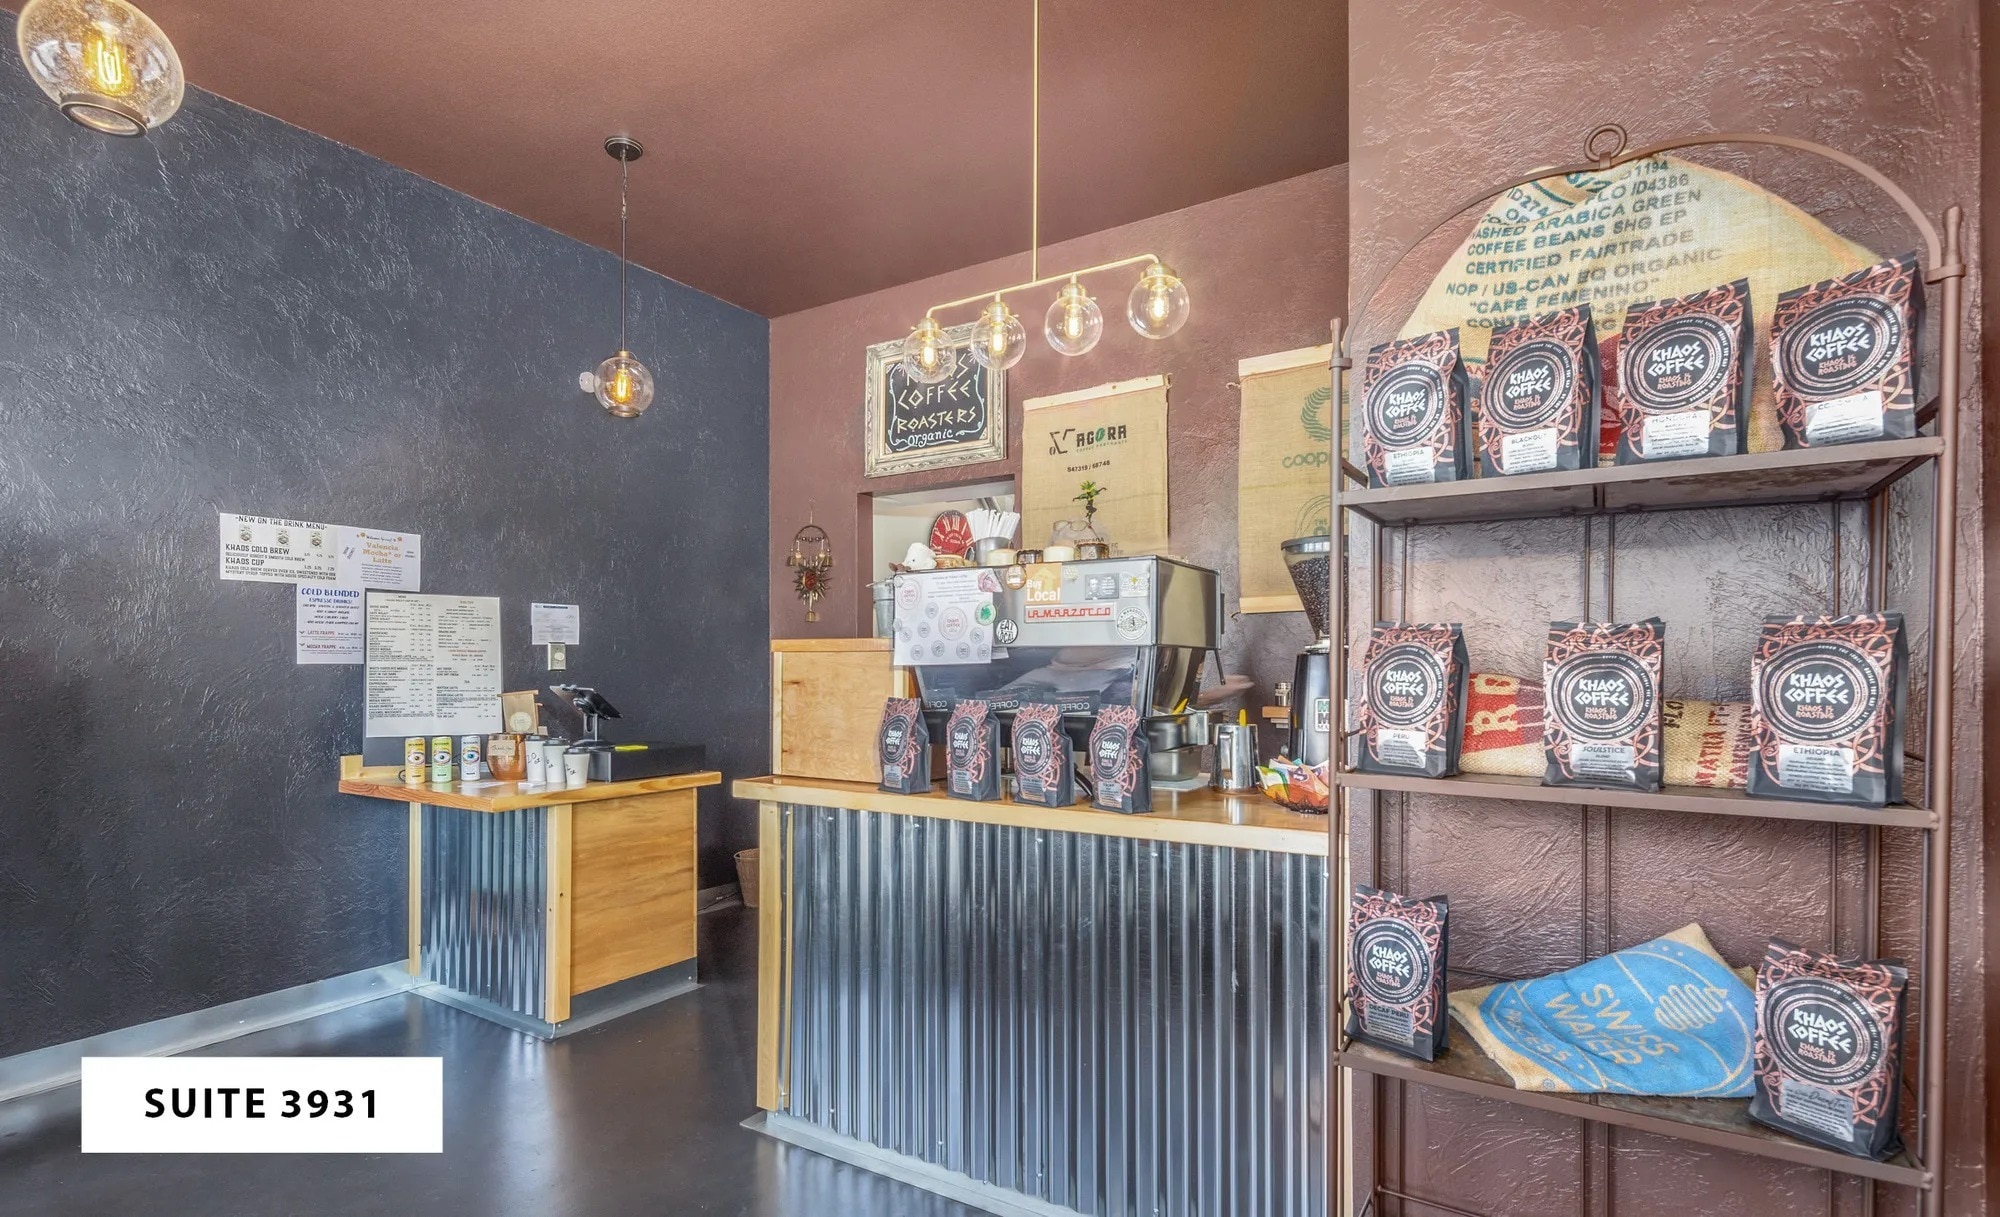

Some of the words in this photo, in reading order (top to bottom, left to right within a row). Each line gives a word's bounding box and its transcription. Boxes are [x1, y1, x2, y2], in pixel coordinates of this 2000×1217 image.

[1532, 203, 1626, 232] ARABICA
[1632, 189, 1701, 213] GREEN
[1467, 239, 1527, 257] COFFEE
[1534, 224, 1605, 249] BEANS
[1613, 217, 1652, 234] SHG
[1659, 210, 1688, 227] EP
[1465, 254, 1561, 275] CERTIFIED
[1569, 229, 1694, 262] FAIRTRADE
[1446, 282, 1478, 296] NOP
[1614, 248, 1722, 278] ORGANIC
[1810, 322, 1866, 347] KHAOS
[1652, 341, 1701, 362] KHAOS
[1805, 333, 1871, 362] COFFEE
[1647, 354, 1705, 377] COFFEE
[1818, 362, 1857, 375] ROASTING
[1819, 357, 1844, 369] KHAOS
[1510, 364, 1549, 385] KHAOS
[898, 379, 971, 410] COFFEE
[1390, 388, 1426, 405] KHAOS
[1505, 377, 1552, 399] COFFEE
[1385, 399, 1426, 418] COFFEE
[897, 406, 976, 433] ROASTERS
[1076, 424, 1127, 447] AGORA
[283, 520, 304, 528] DRINK
[225, 544, 249, 552] KHAOS
[269, 547, 290, 555] BREW
[225, 557, 249, 565] KHAOS
[251, 558, 265, 566] CUP
[324, 589, 360, 598] BLENDED
[1026, 579, 1043, 591] Buy
[1026, 587, 1061, 602] Local
[1000, 620, 1014, 630] EAT
[1386, 670, 1422, 683] KHAOS
[1578, 678, 1625, 692] KHAOS
[1789, 672, 1846, 688] KHAOS
[1382, 682, 1424, 696] COFFEE
[1574, 691, 1630, 706] COFFEE
[1784, 687, 1849, 704] COFFEE
[1793, 747, 1840, 756] ETHIOPIA
[1373, 944, 1408, 964] KHAOS
[1368, 957, 1410, 978] COFFEE
[1793, 1008, 1849, 1035] KHAOS
[1788, 1024, 1852, 1054] COFFEE
